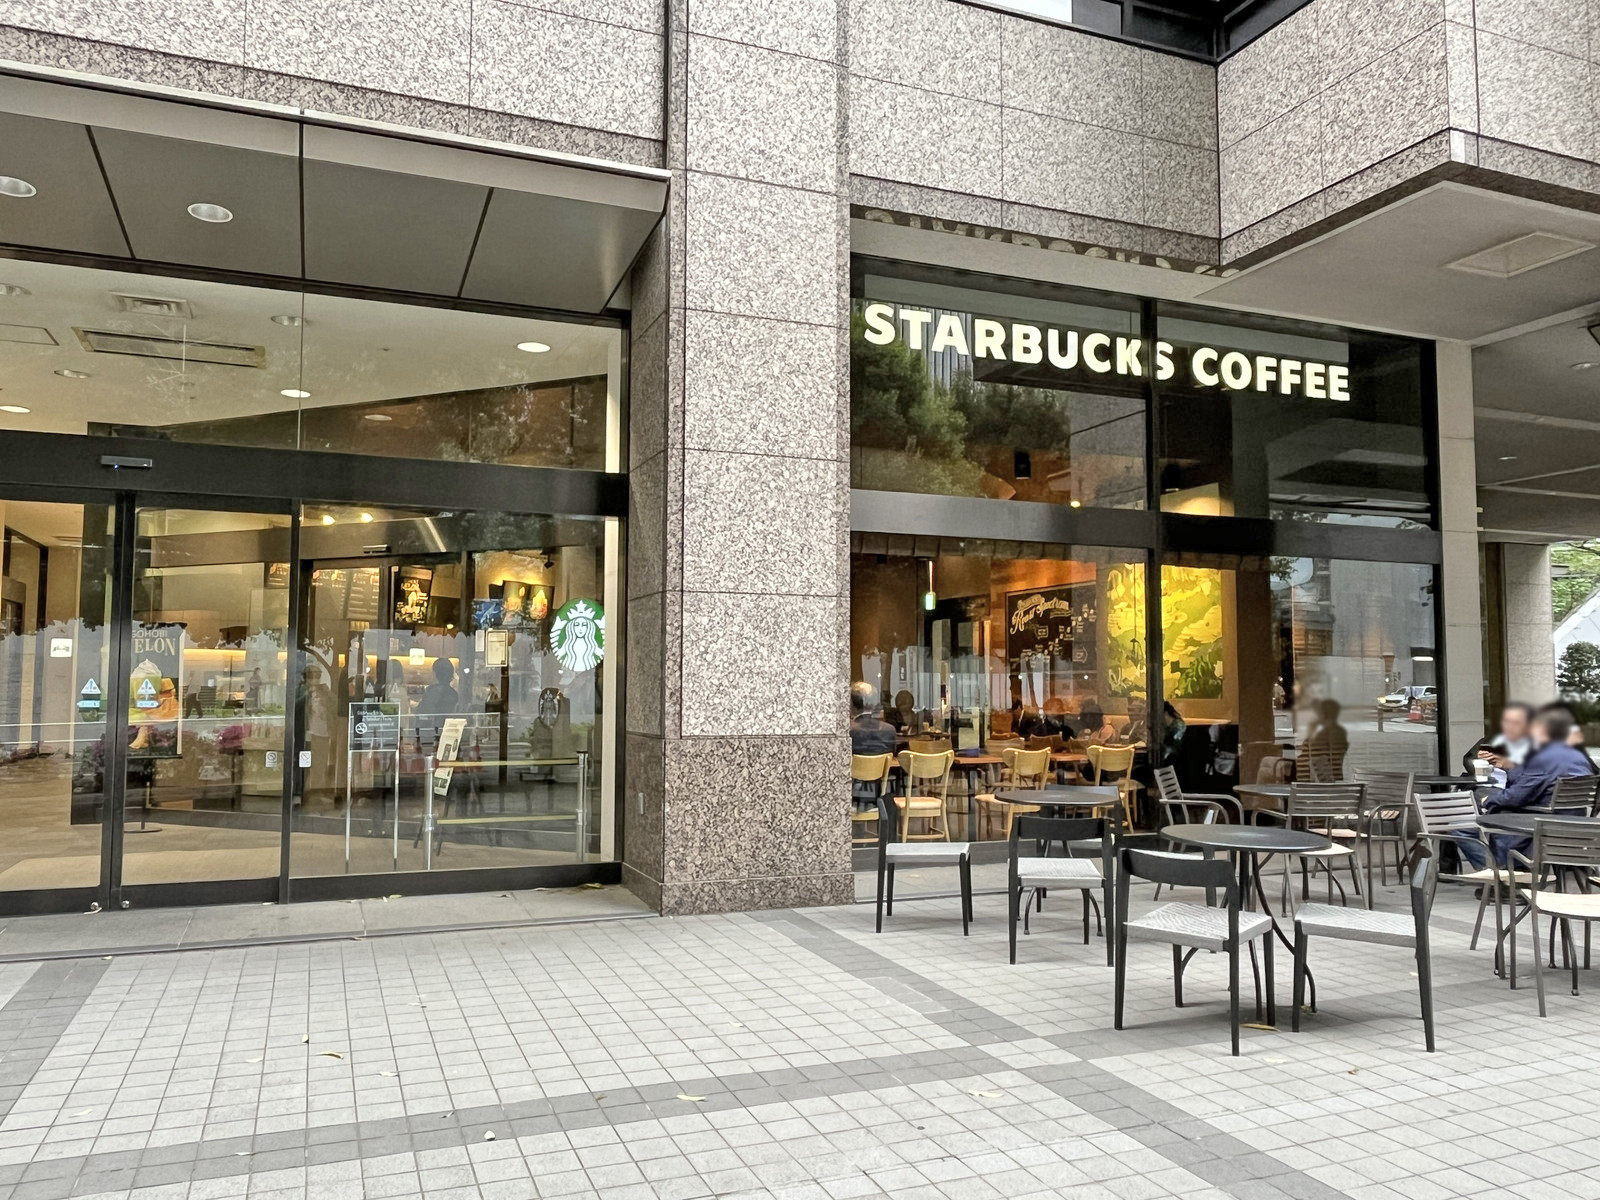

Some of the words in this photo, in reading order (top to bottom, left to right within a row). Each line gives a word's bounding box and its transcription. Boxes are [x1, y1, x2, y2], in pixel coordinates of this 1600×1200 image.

[864, 303, 1175, 380] STARBUCKS
[1192, 347, 1350, 401] COFFEE
[134, 637, 176, 656] ELON
